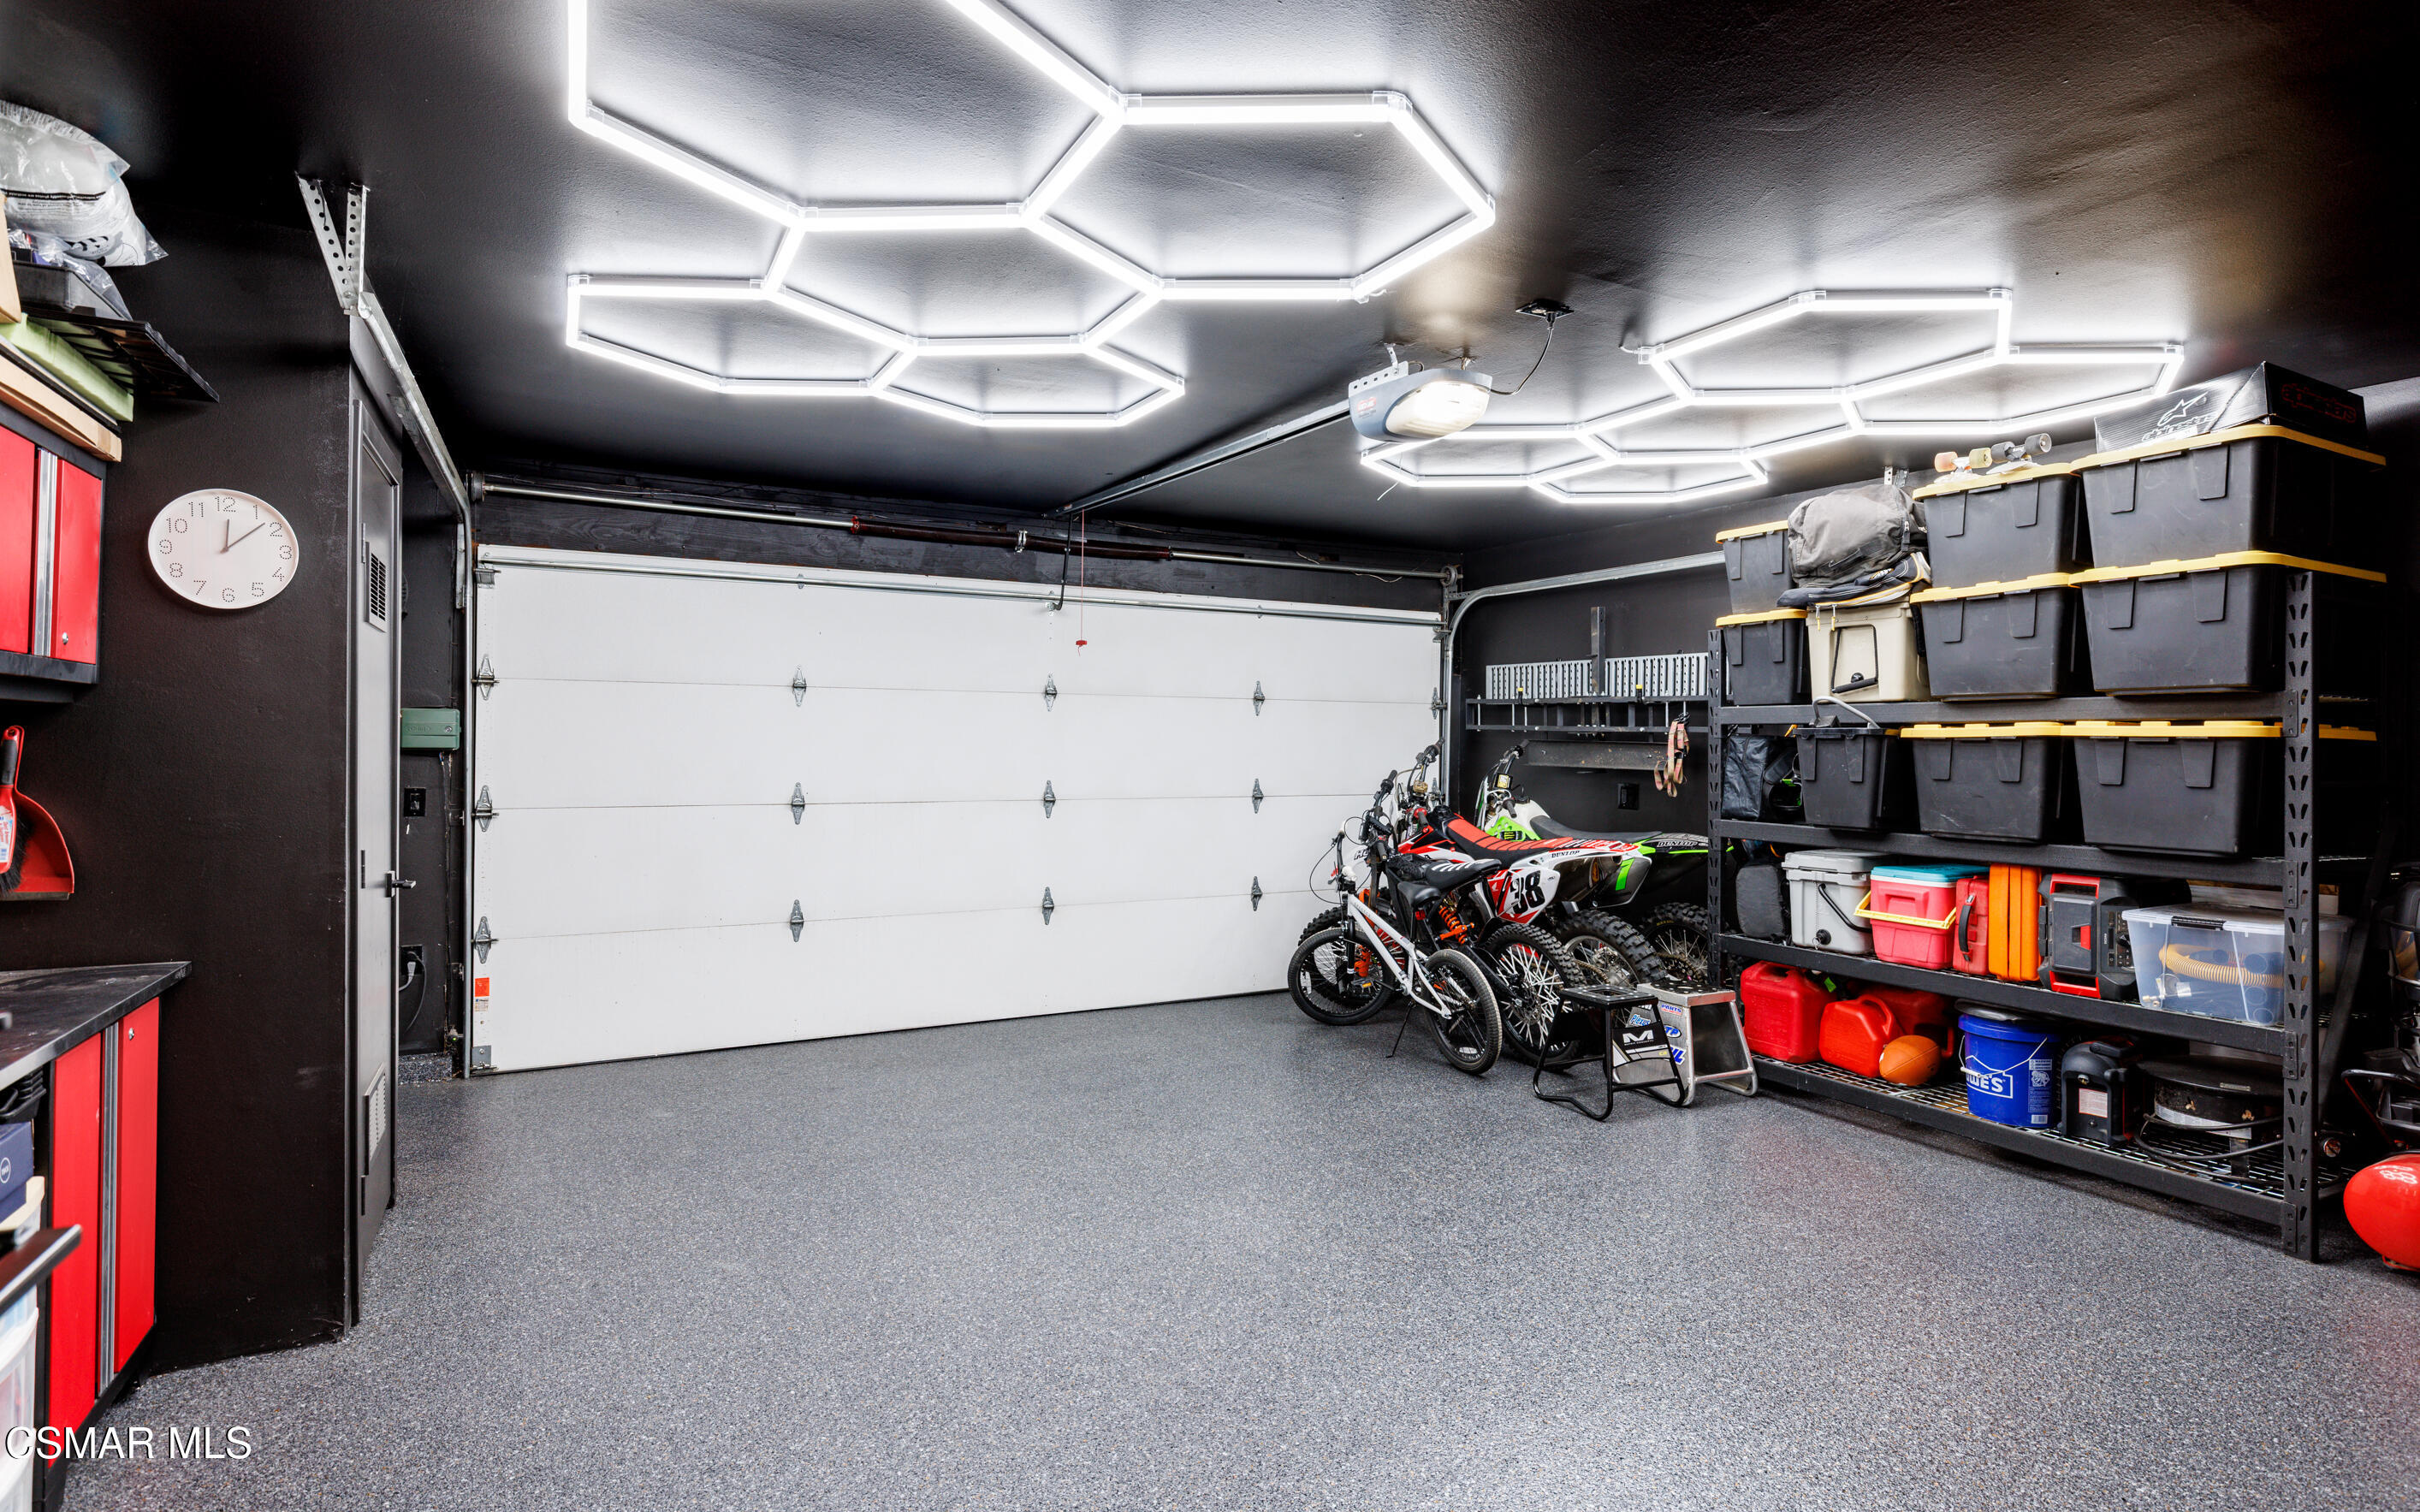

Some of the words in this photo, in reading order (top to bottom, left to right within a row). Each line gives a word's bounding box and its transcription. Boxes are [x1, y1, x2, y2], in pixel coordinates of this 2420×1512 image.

[188, 501, 204, 518] 11
[215, 496, 236, 513] 12
[252, 504, 258, 519] 1
[166, 518, 188, 534] 10
[270, 522, 283, 537] 2
[159, 539, 173, 554] 9
[279, 545, 293, 560] 3
[169, 562, 183, 578] 8
[271, 566, 285, 582] 4
[193, 580, 207, 596] 7
[222, 588, 235, 602] 6
[252, 583, 264, 597] 5
[1551, 850, 1580, 858] DUNLOP
[1510, 869, 1545, 914] 38
[1661, 1004, 1682, 1013] PARTS
[1664, 1026, 1679, 1035] TP
